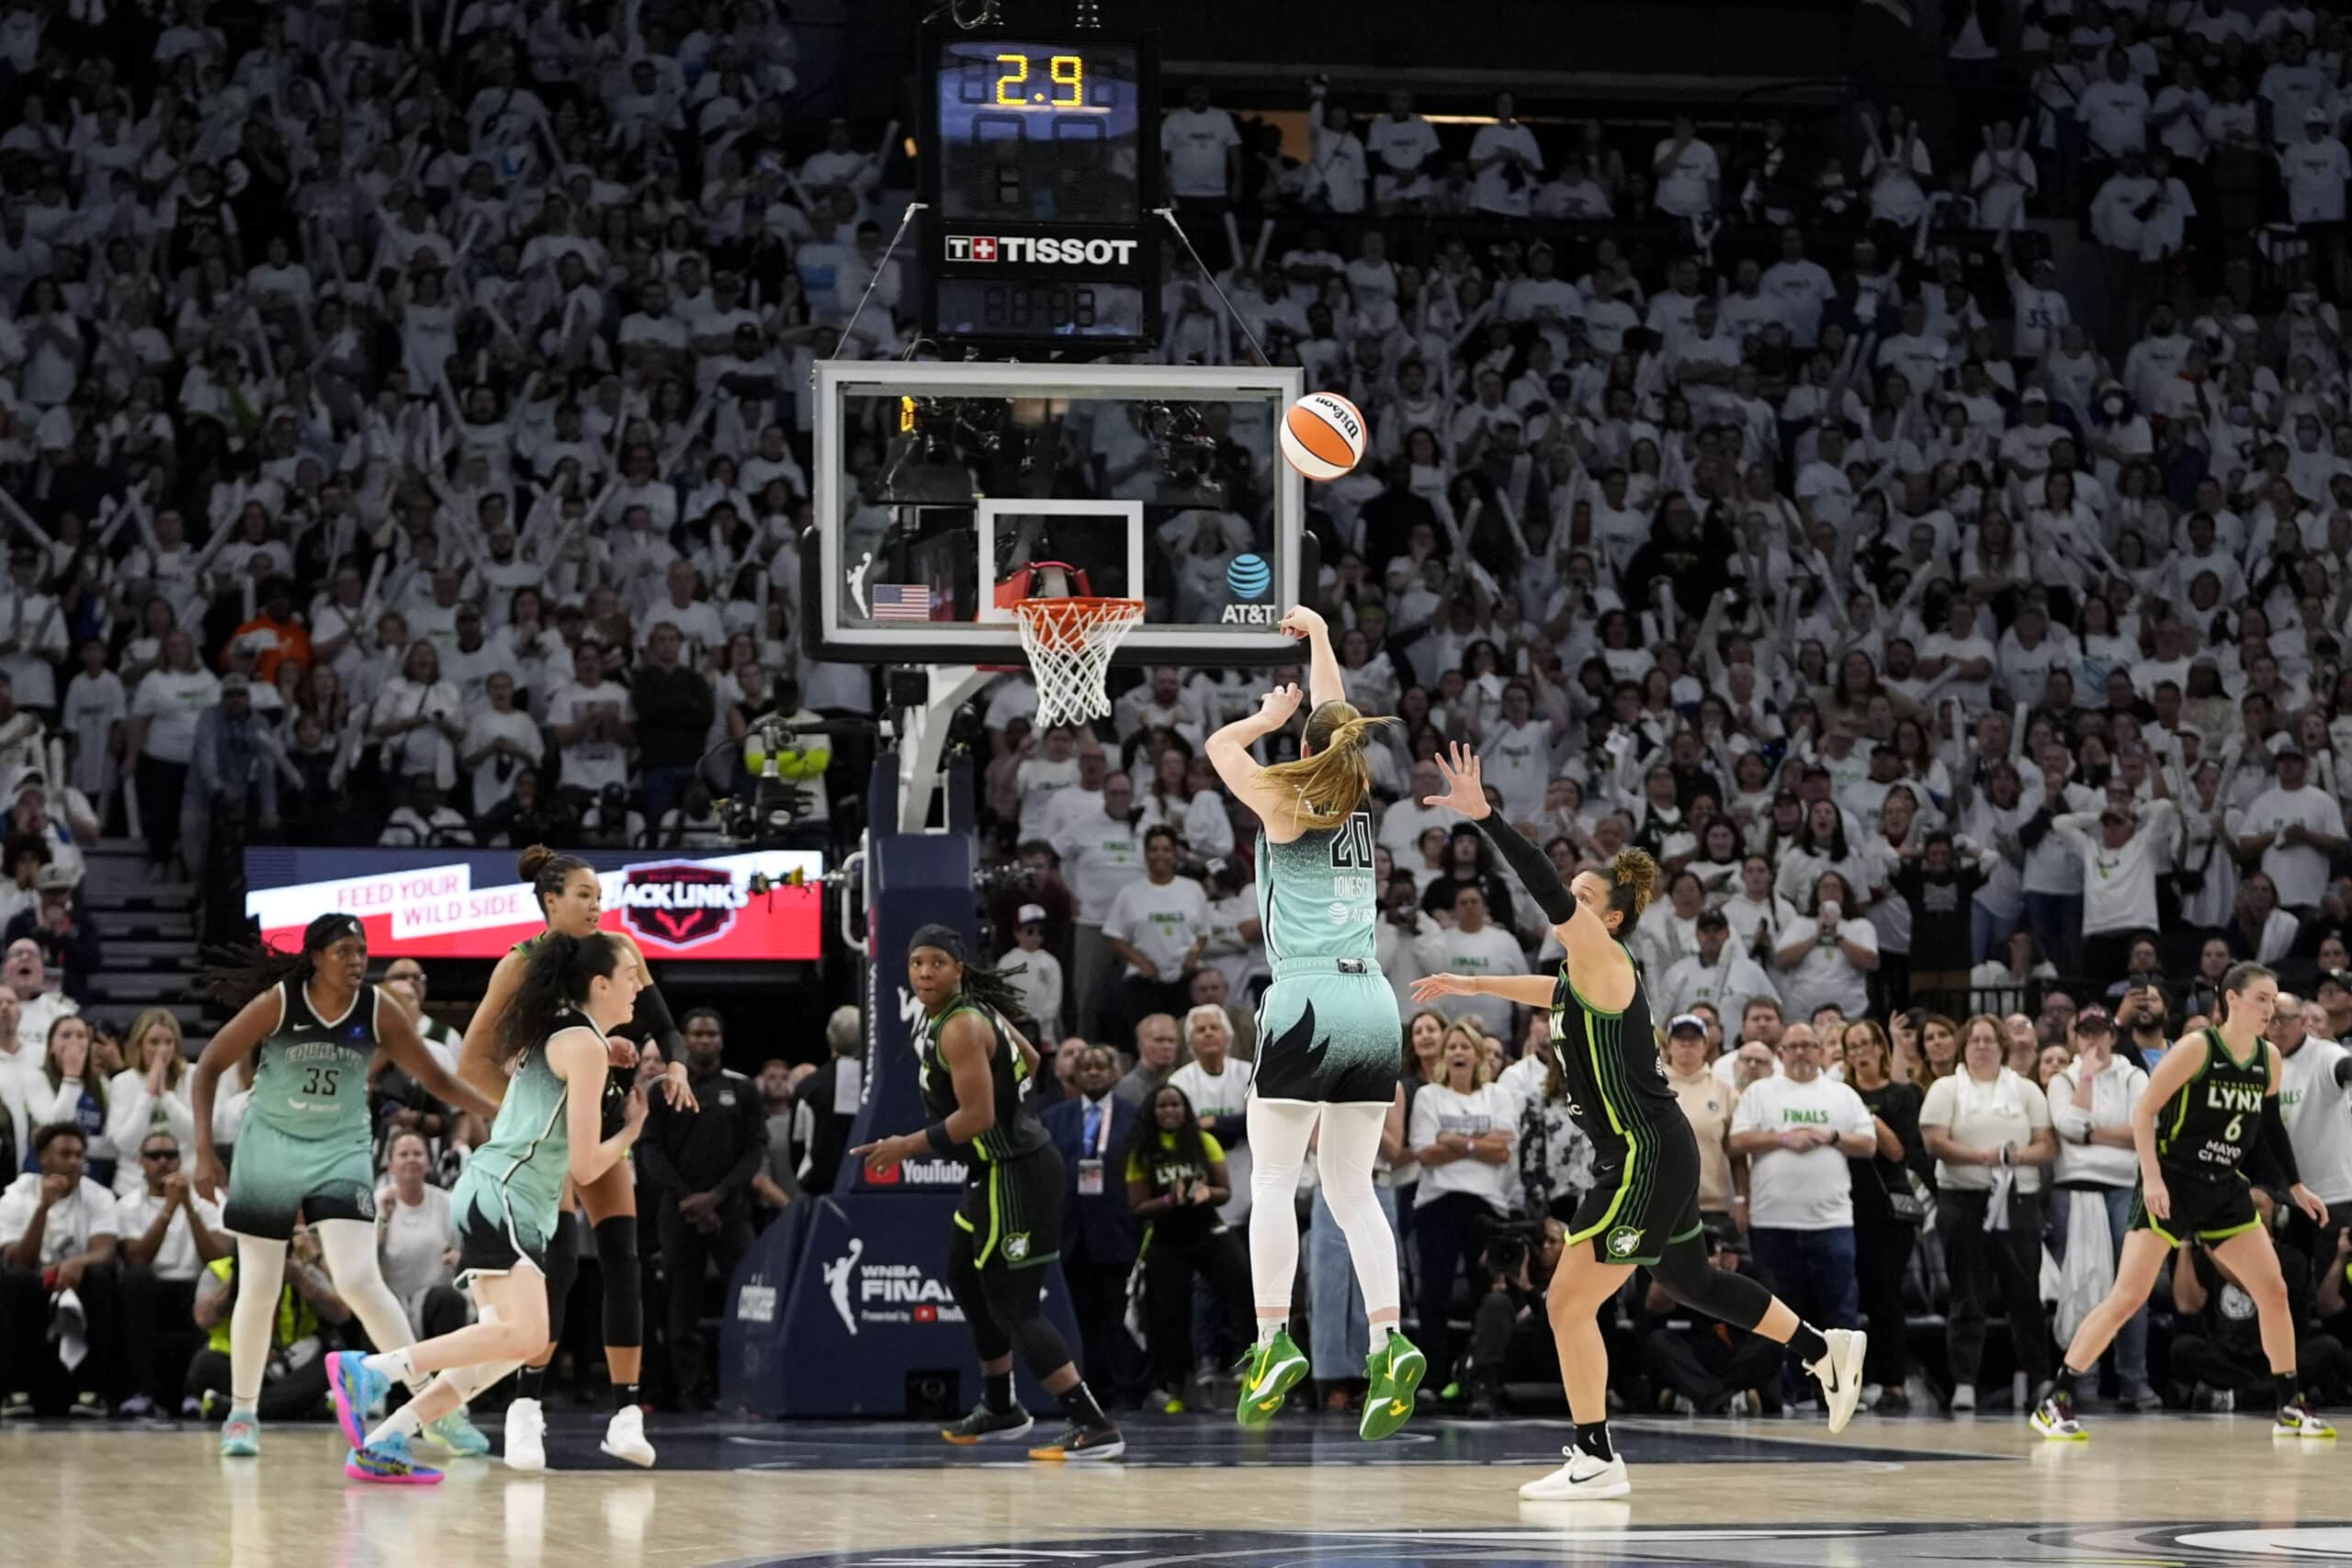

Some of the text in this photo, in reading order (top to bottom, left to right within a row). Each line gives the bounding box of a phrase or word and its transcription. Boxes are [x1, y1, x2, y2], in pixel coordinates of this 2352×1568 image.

[997, 54, 1082, 106] 2.9
[999, 237, 1137, 265] TISSOT
[1315, 397, 1359, 439] Wilson
[1221, 604, 1276, 626] AT&T
[1329, 812, 1374, 870] 20
[337, 874, 459, 908] FEED YOUR
[403, 901, 462, 927] WILD
[302, 1067, 340, 1096] 35
[2207, 1086, 2263, 1113] LYNX
[1782, 1108, 1828, 1123] FINALS
[2224, 1113, 2244, 1142] 6
[2206, 1140, 2242, 1158] MAYO
[861, 1265, 922, 1278] WNBA
[862, 1279, 955, 1302] FINA
